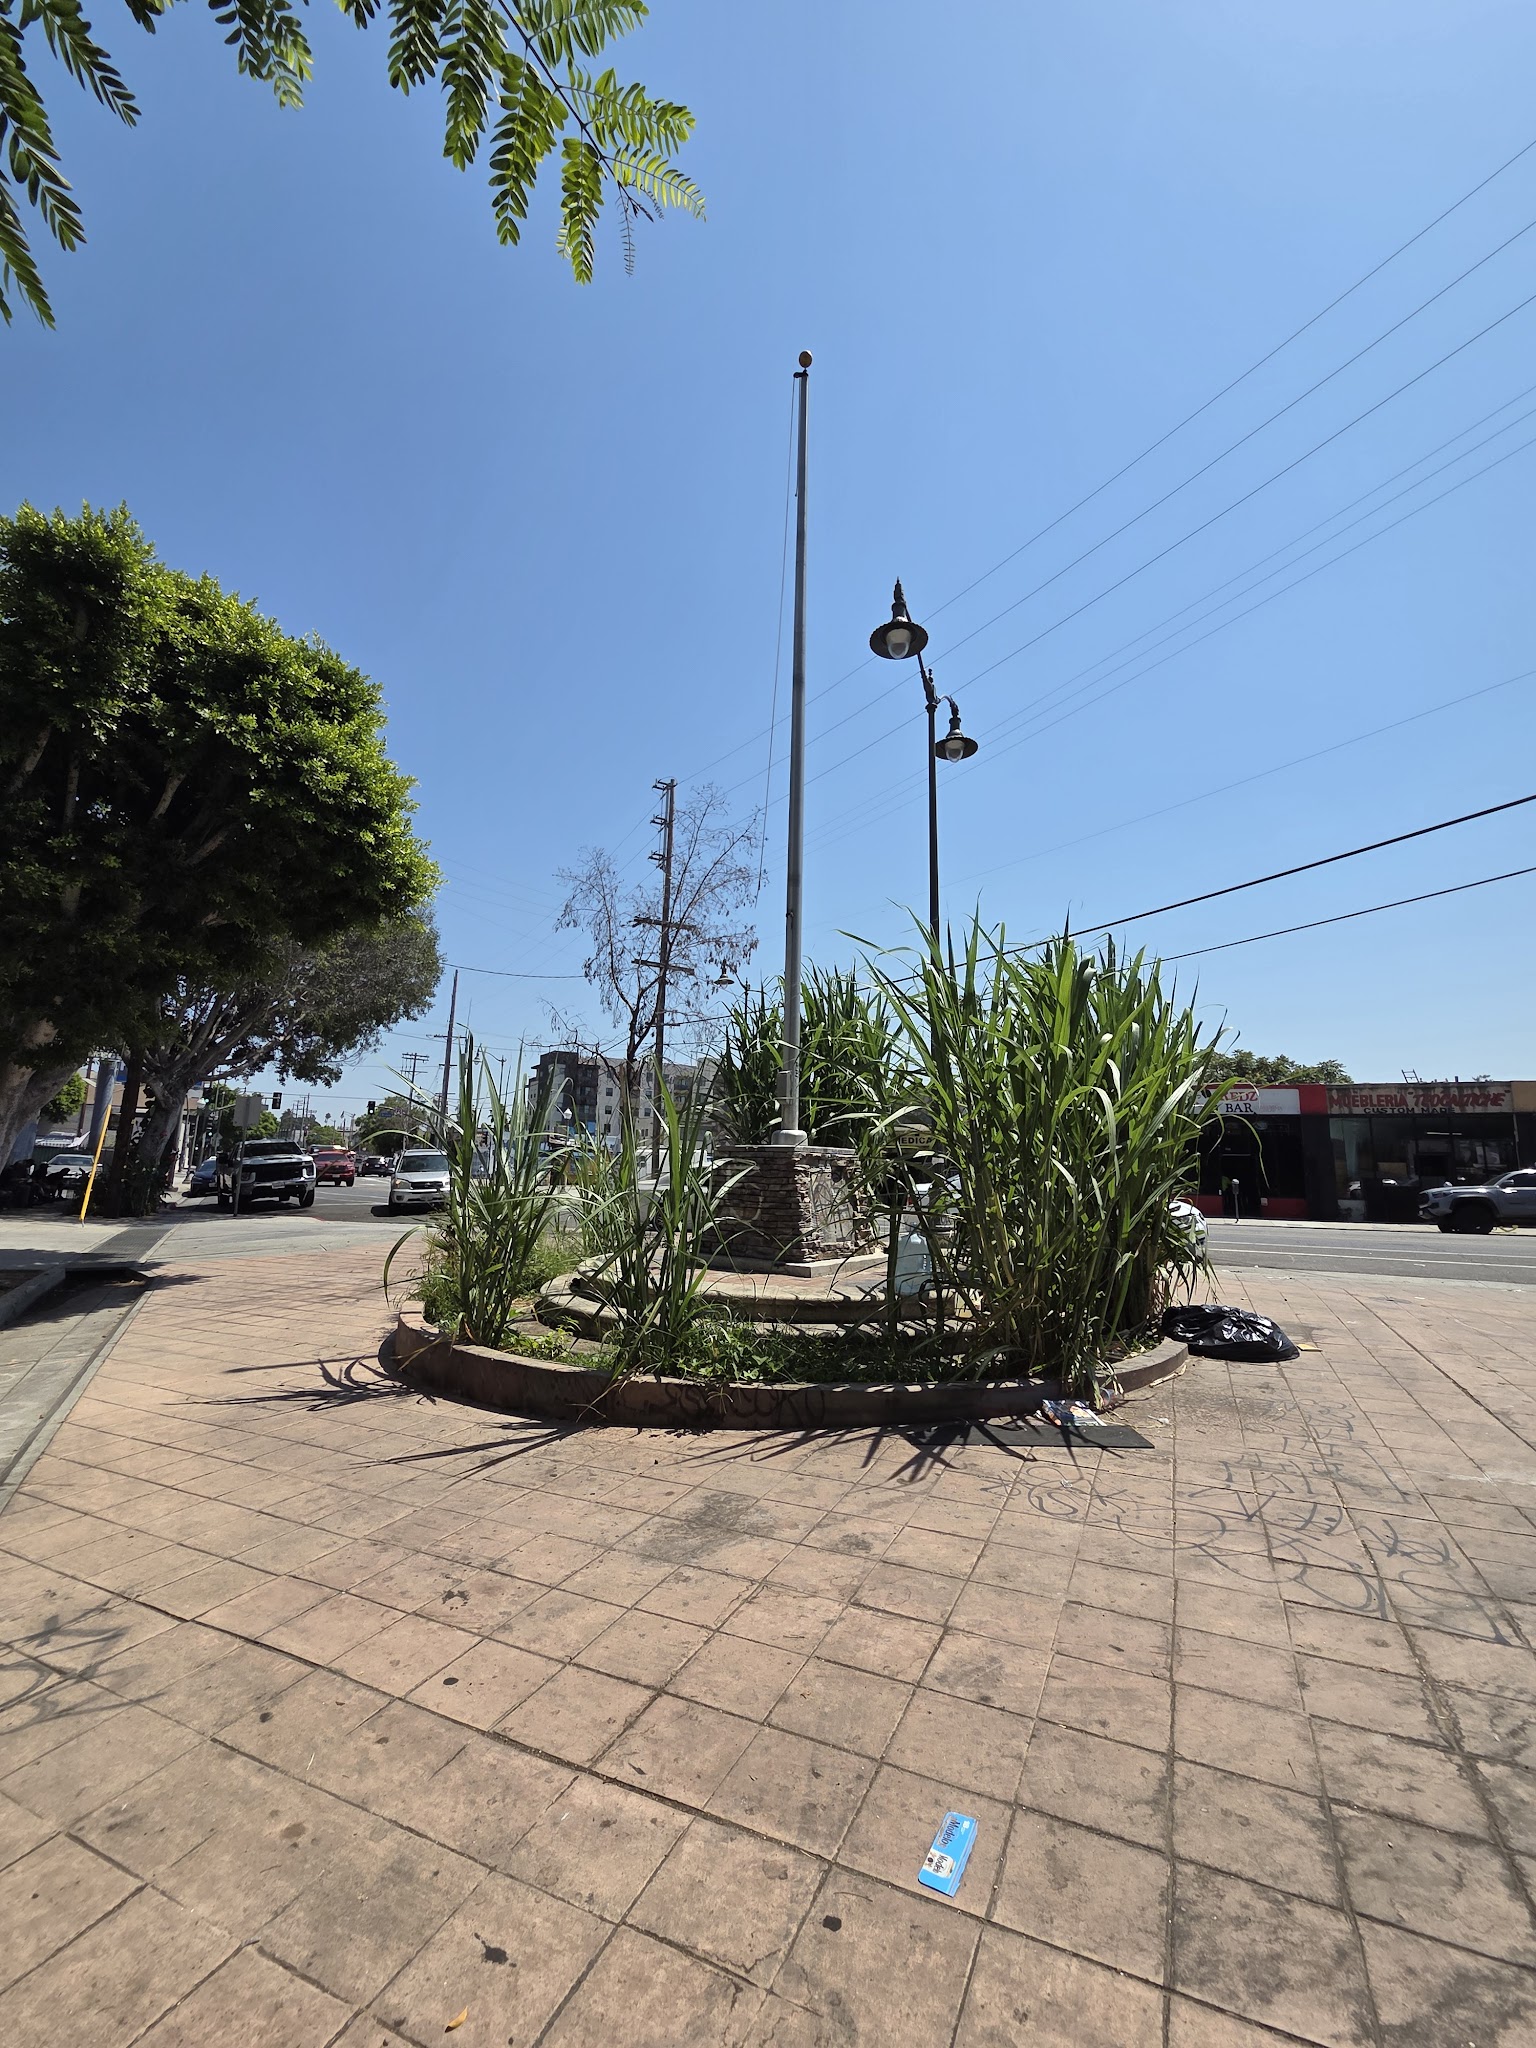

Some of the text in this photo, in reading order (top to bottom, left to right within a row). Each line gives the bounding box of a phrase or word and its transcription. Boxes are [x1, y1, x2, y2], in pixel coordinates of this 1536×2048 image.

[1225, 1103, 1253, 1113] BAR
[1330, 1094, 1408, 1108] MUEBLERIA
[941, 1818, 961, 1846] Modelo
